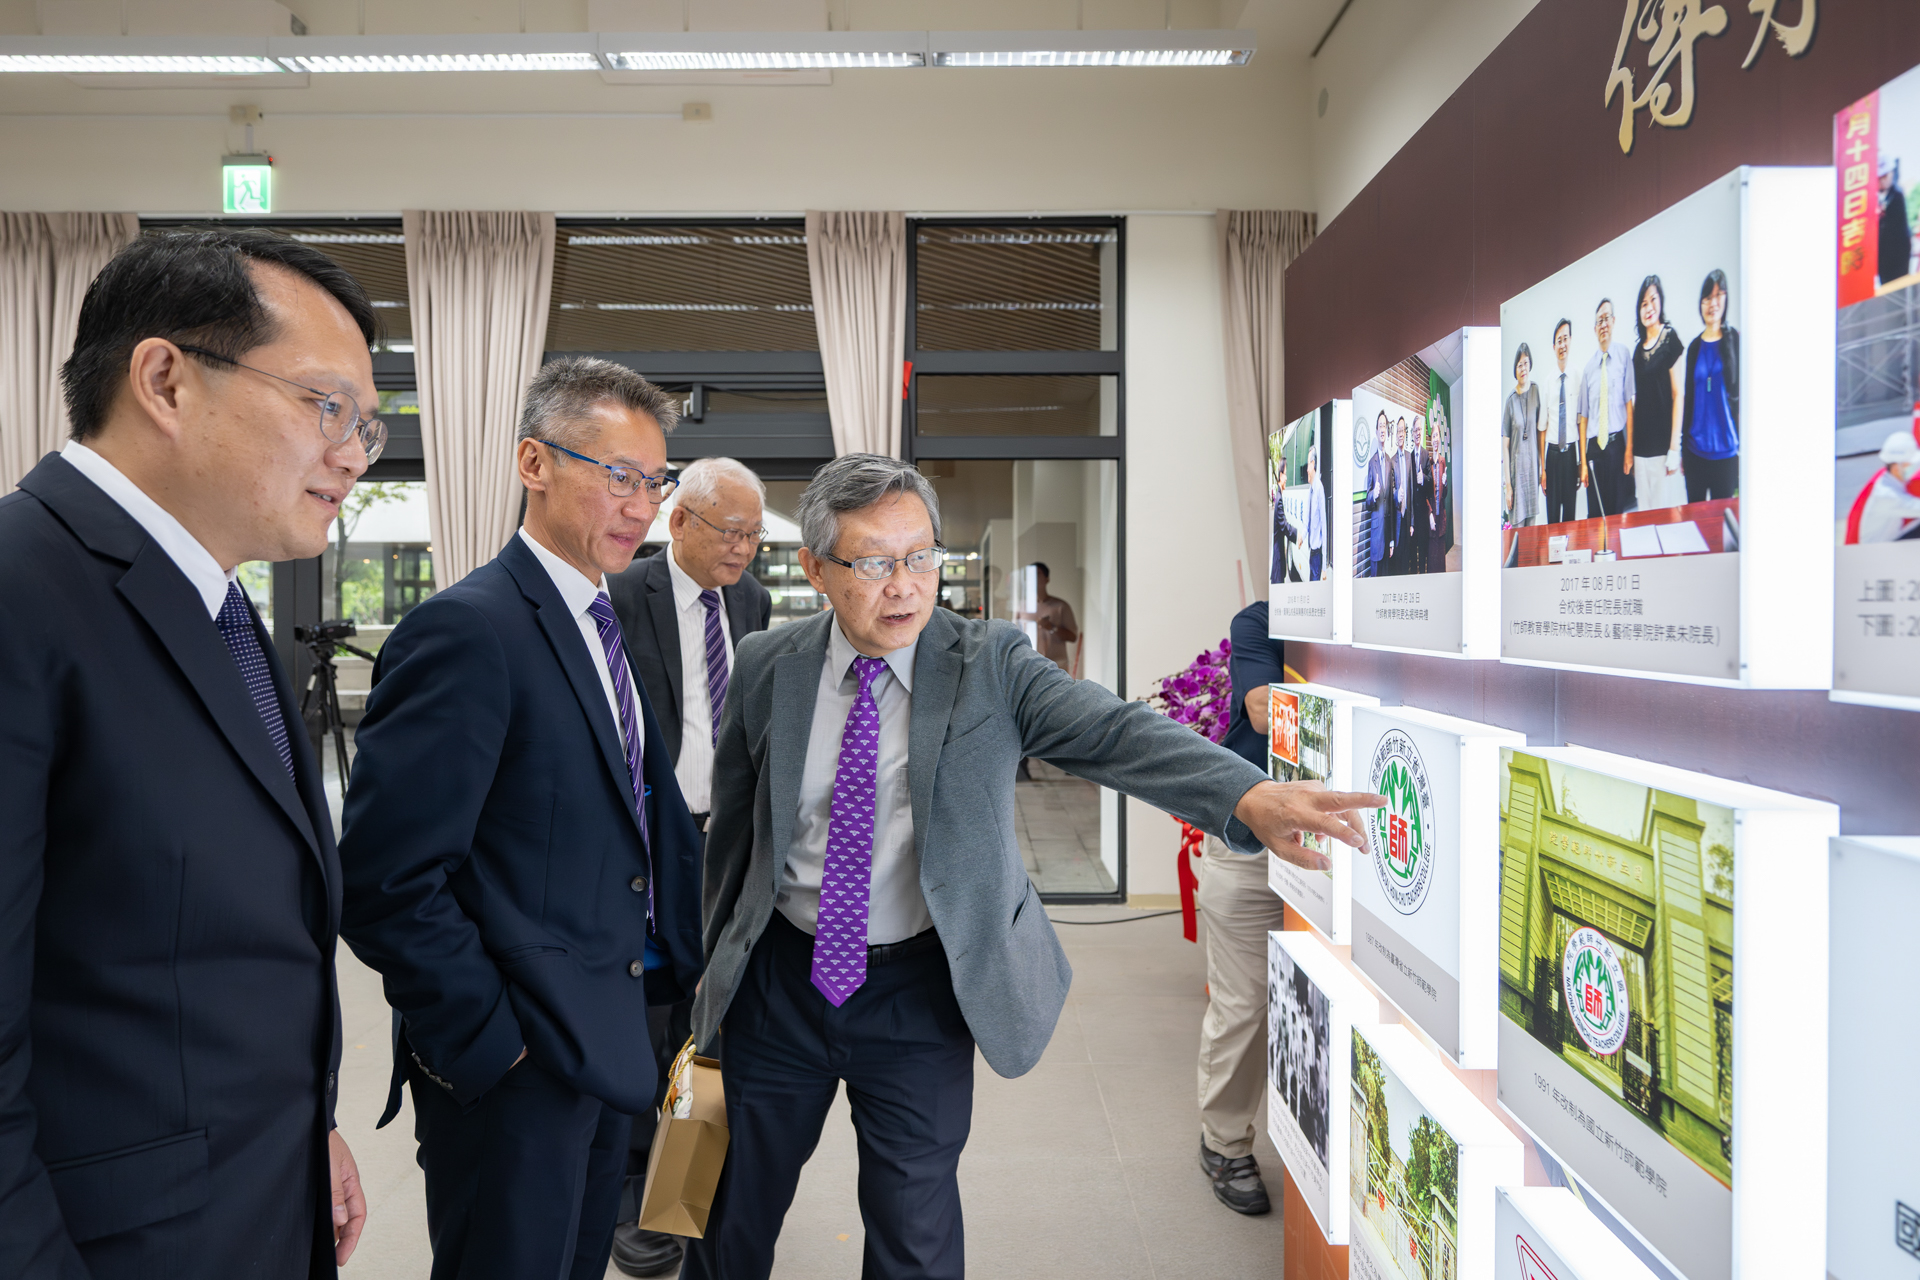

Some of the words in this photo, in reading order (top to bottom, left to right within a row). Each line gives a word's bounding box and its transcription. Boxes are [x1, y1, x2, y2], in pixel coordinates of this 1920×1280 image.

[1561, 577, 1579, 591] 2017
[1582, 577, 1590, 591] 年
[1593, 577, 1603, 591] 08
[1605, 575, 1614, 591] 月
[1617, 576, 1627, 590] 01
[1632, 574, 1640, 590] 日
[1558, 598, 1644, 616] 合校後首任院長就職
[1420, 842, 1430, 884] COLLEGE
[1566, 976, 1576, 1015] NATIONAL
[1534, 1072, 1550, 1096] 1991
[1552, 1087, 1667, 1198] 年改制為國立新竹師範學院
